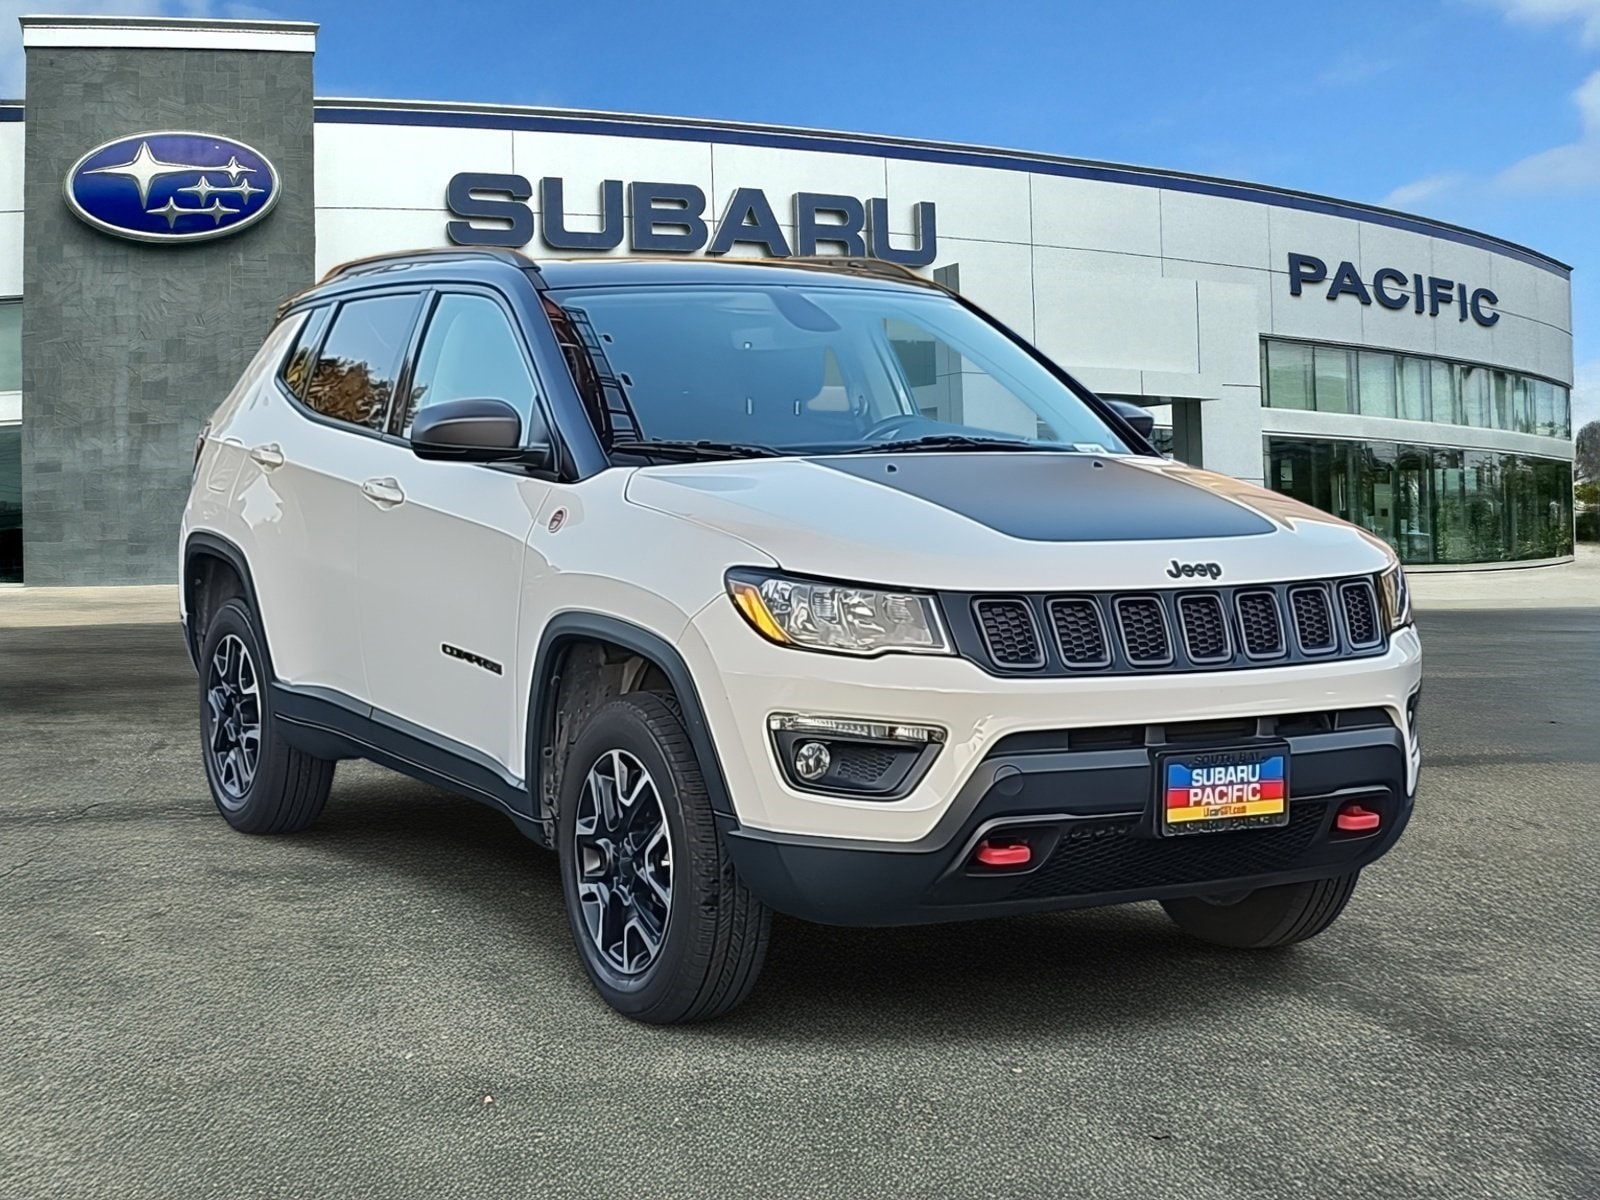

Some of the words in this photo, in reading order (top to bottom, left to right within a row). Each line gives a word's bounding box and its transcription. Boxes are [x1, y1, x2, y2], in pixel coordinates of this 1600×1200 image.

[446, 171, 937, 267] SUBARU
[1288, 252, 1500, 327] PACIFIC
[1166, 560, 1222, 580] Jeep
[1191, 764, 1260, 787] SUBARU
[1188, 783, 1261, 806] PACIFIC
